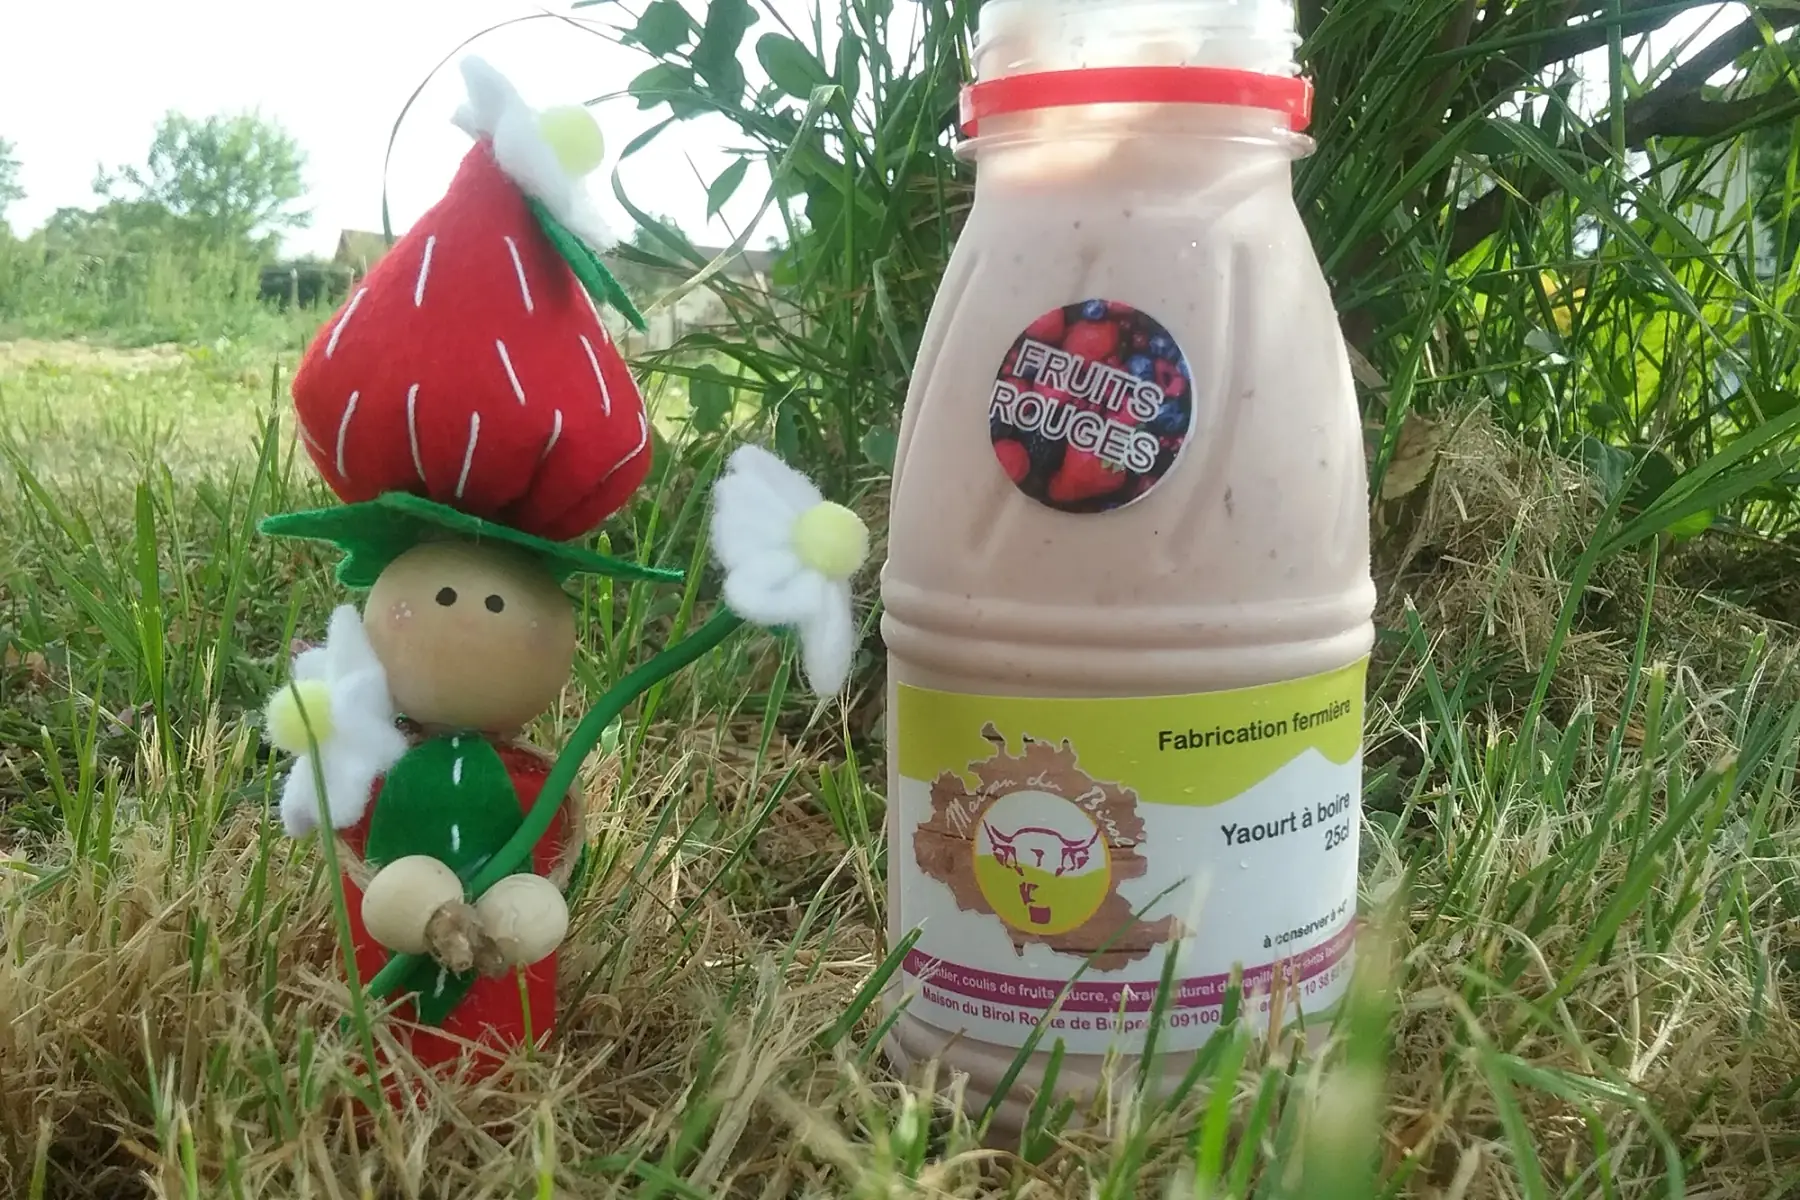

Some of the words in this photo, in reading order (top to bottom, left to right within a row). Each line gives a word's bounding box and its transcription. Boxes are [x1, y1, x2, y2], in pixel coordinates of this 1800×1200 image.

[1013, 338, 1164, 422] FRUITS
[989, 380, 1160, 473] ROUGES
[1158, 720, 1288, 752] Fabrication
[1292, 699, 1351, 732] fermière
[1221, 810, 1298, 846] Yaourt
[1302, 807, 1313, 829] à
[1317, 793, 1350, 823] boire
[1324, 817, 1350, 851] 25cl
[1274, 914, 1330, 945] conserver
[922, 985, 960, 1012] Maison
[962, 1000, 979, 1017] du
[981, 1004, 1015, 1024] Birol
[1018, 1010, 1065, 1029] Rote
[1069, 1015, 1091, 1030] de
[1169, 1008, 1220, 1028] 09100
[962, 976, 997, 992] coulis
[999, 981, 1016, 996] de
